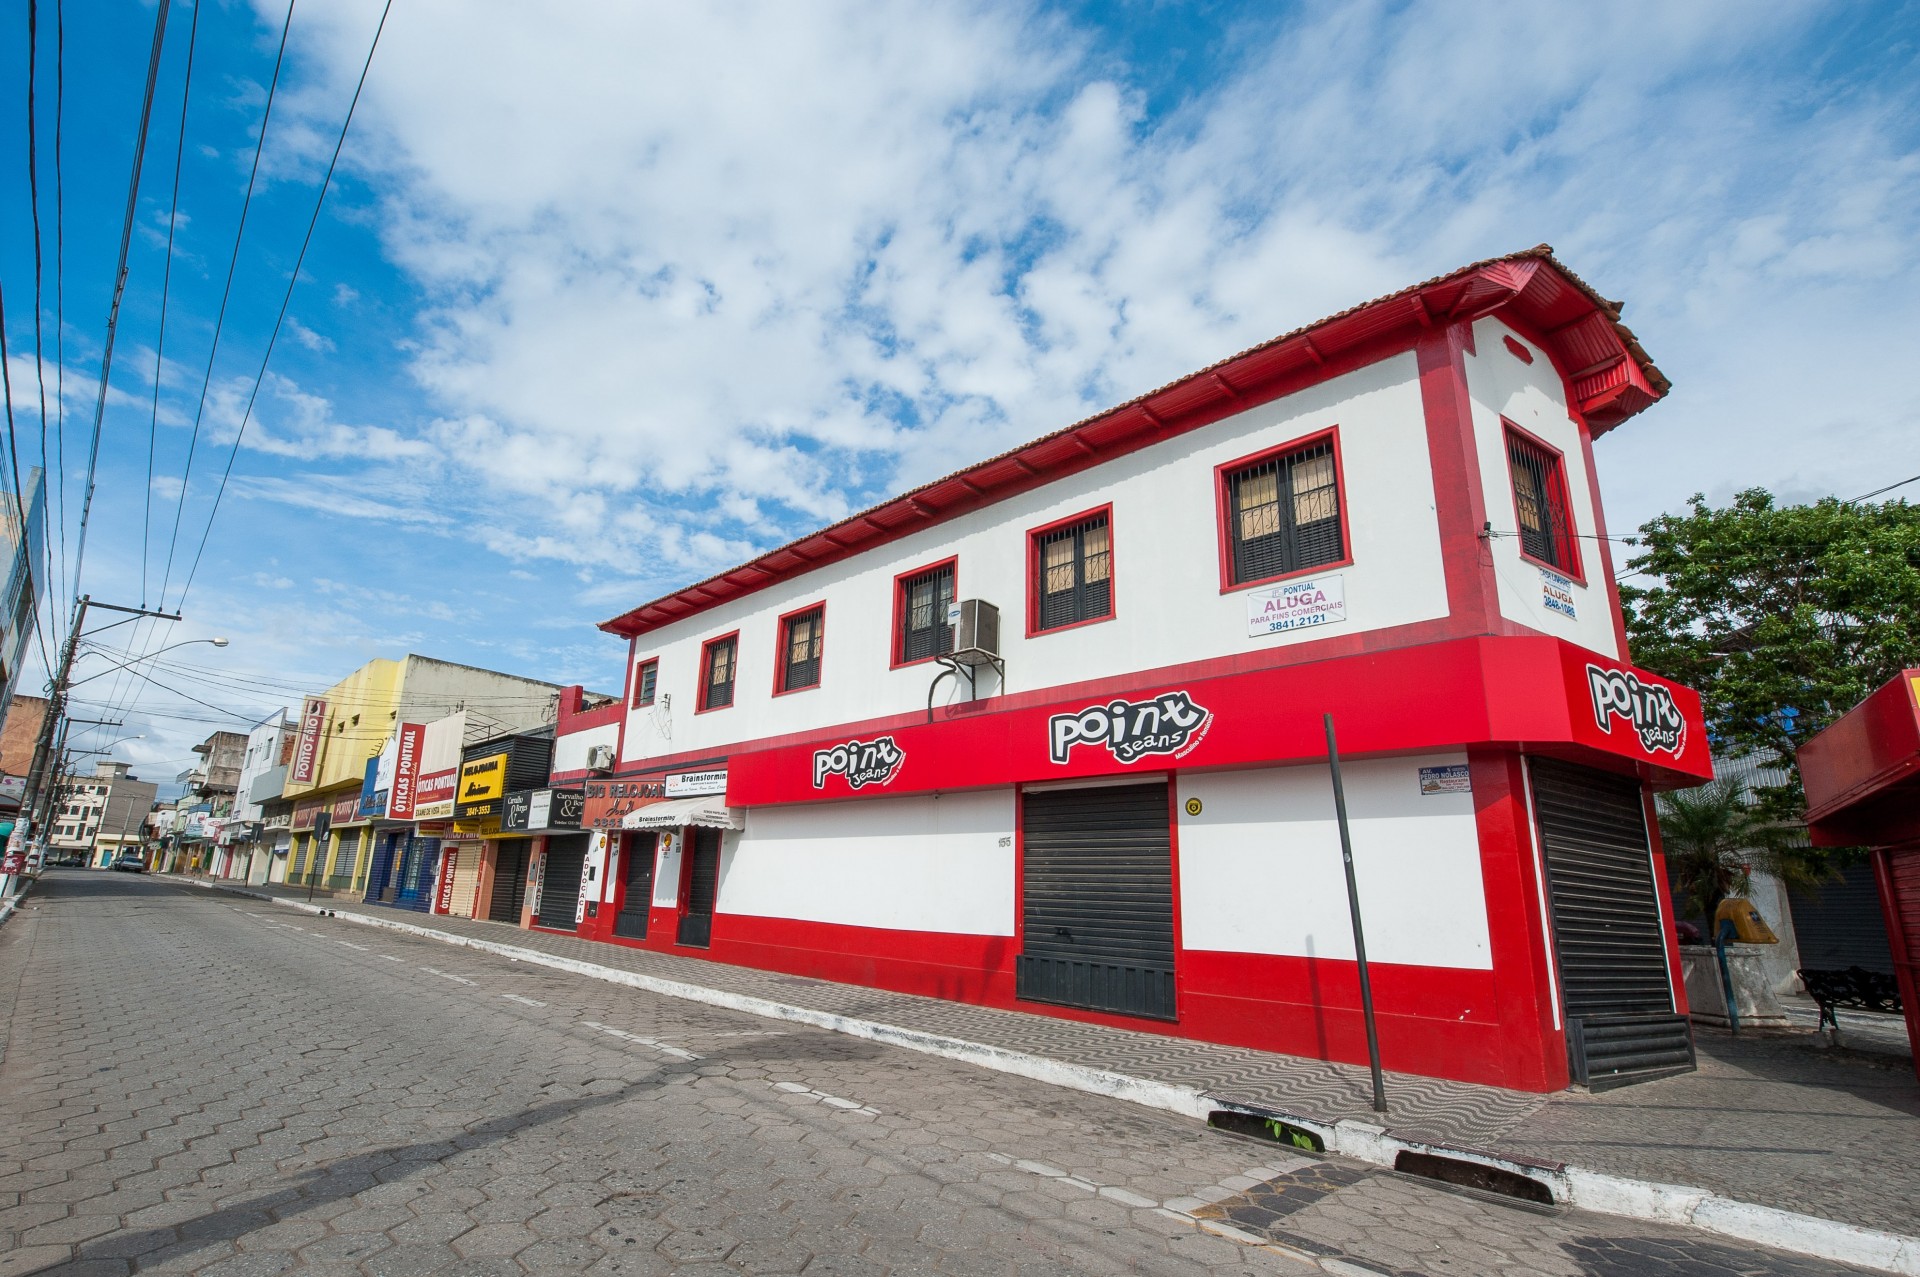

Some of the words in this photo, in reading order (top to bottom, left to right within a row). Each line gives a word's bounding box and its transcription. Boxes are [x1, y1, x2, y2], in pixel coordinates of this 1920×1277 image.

[1283, 582, 1316, 595] PONTUAL
[1543, 585, 1575, 605] ALUGA
[1250, 615, 1270, 625] PARA
[1272, 611, 1290, 621] FINS
[1291, 601, 1343, 617] COMERCIAIS
[1264, 590, 1327, 613] ALUGA
[1269, 613, 1326, 631] 3841.2121
[297, 742, 313, 778] PONTO
[400, 730, 416, 775] PONTUAL
[1175, 740, 1200, 760] Masculino
[1441, 770, 1469, 778] NOLASCO
[392, 777, 410, 813] ÓTICAS
[556, 792, 584, 801] Carvalho
[586, 784, 606, 799] BIG
[445, 851, 457, 883] PONTUAL
[440, 882, 453, 909] ÓTICAS
[533, 853, 546, 915] ADVOCACIA
[576, 855, 590, 922] ADVOCACIA
